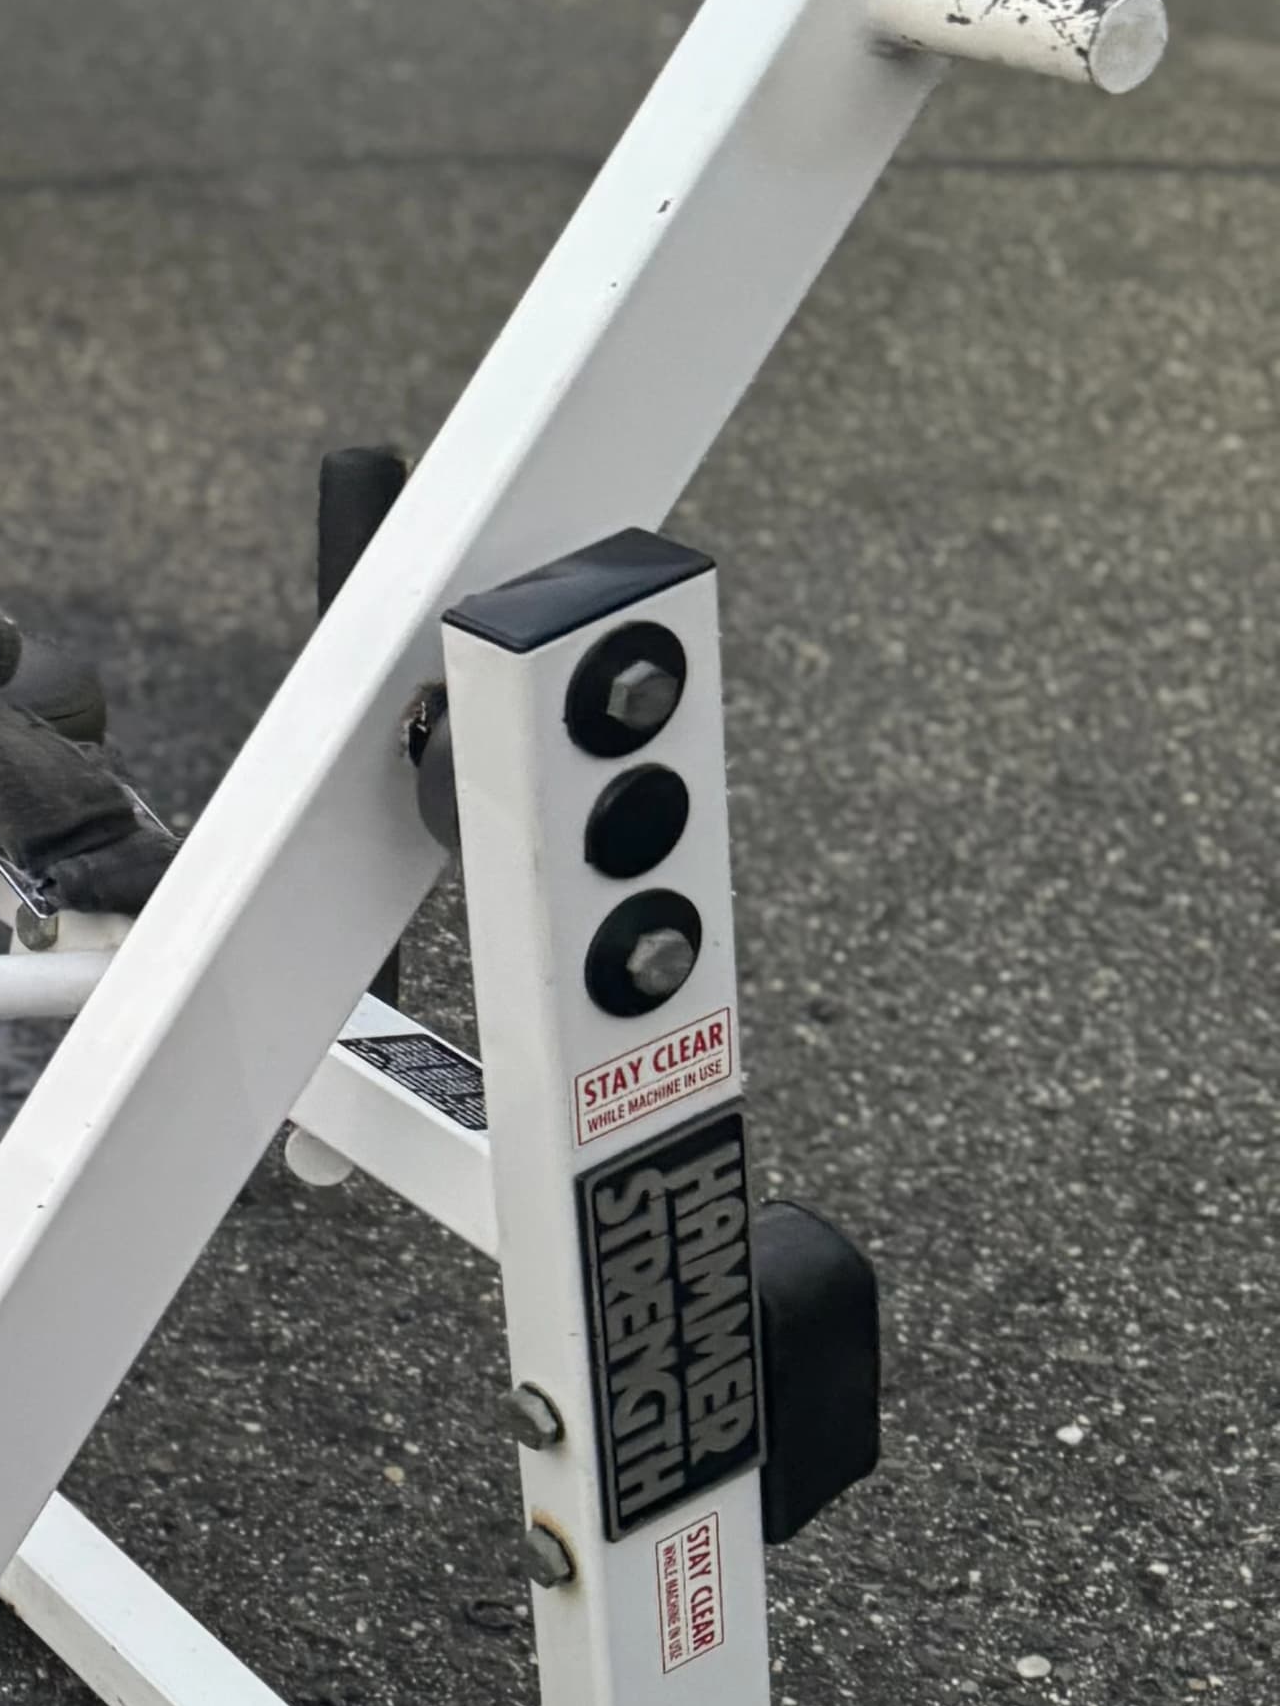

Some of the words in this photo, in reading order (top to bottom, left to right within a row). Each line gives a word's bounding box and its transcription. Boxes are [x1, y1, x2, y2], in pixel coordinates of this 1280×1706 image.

[584, 1056, 643, 1107] STAY
[652, 1022, 724, 1073] CLEAR
[587, 1104, 625, 1133] WHILE
[628, 1077, 681, 1115] MACHINE
[684, 1071, 697, 1089] IN
[699, 1059, 723, 1082] USE
[595, 1167, 686, 1518] STRENGTH
[663, 1141, 755, 1465] HAMMER
[687, 1524, 712, 1580] STAY
[690, 1585, 716, 1651] CLEAR
